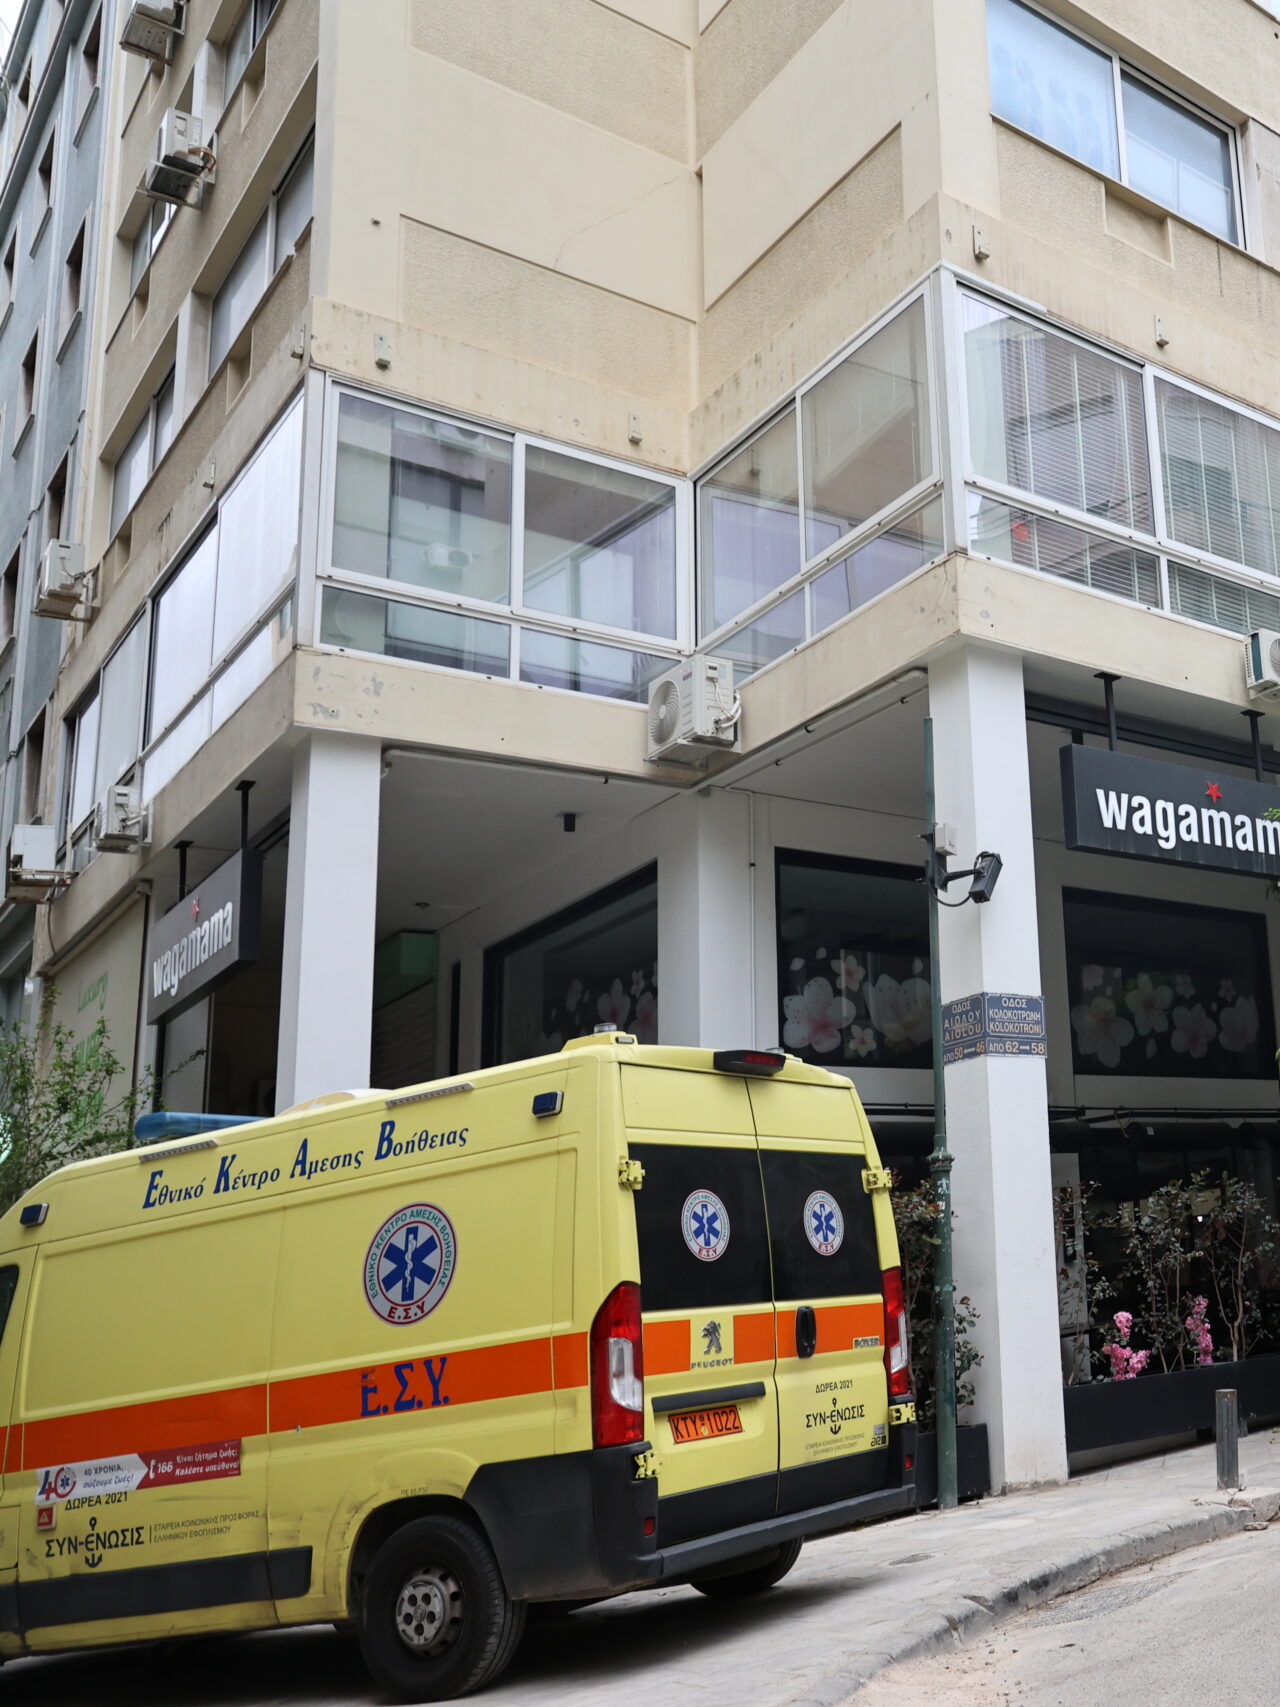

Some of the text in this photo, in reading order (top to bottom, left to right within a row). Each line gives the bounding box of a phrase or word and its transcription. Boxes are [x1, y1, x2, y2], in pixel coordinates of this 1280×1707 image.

[153, 901, 233, 998] wagamama
[952, 1000, 972, 1014] ΟΔΟΣ
[1001, 997, 1028, 1008] ΟΔΟΣ
[989, 1008, 1041, 1021] ΚΟΛΟΚΟΤΡΩΝΗ
[989, 1021, 1041, 1034] KOLOKOTRONI
[989, 1042, 1005, 1052] ΑΠΟ
[142, 1169, 206, 1209] Εθνικό
[213, 1153, 281, 1194] Κέντρο
[374, 1120, 469, 1161] Βοήθειας
[368, 1208, 452, 1299] ΕΘΝΙΚΟ ΚΕΝΤΡΟ ΑΜΕΣΗΣ ΒΟΗΘΕΙΑΣ
[690, 1357, 734, 1369] PEUGEOT
[815, 1379, 853, 1393] ΔΩΡΕΑ 2021
[706, 1409, 741, 1435] 1022
[157, 1461, 174, 1474] 166
[64, 1491, 128, 1511] ΔΩΡΕΑ 2021
